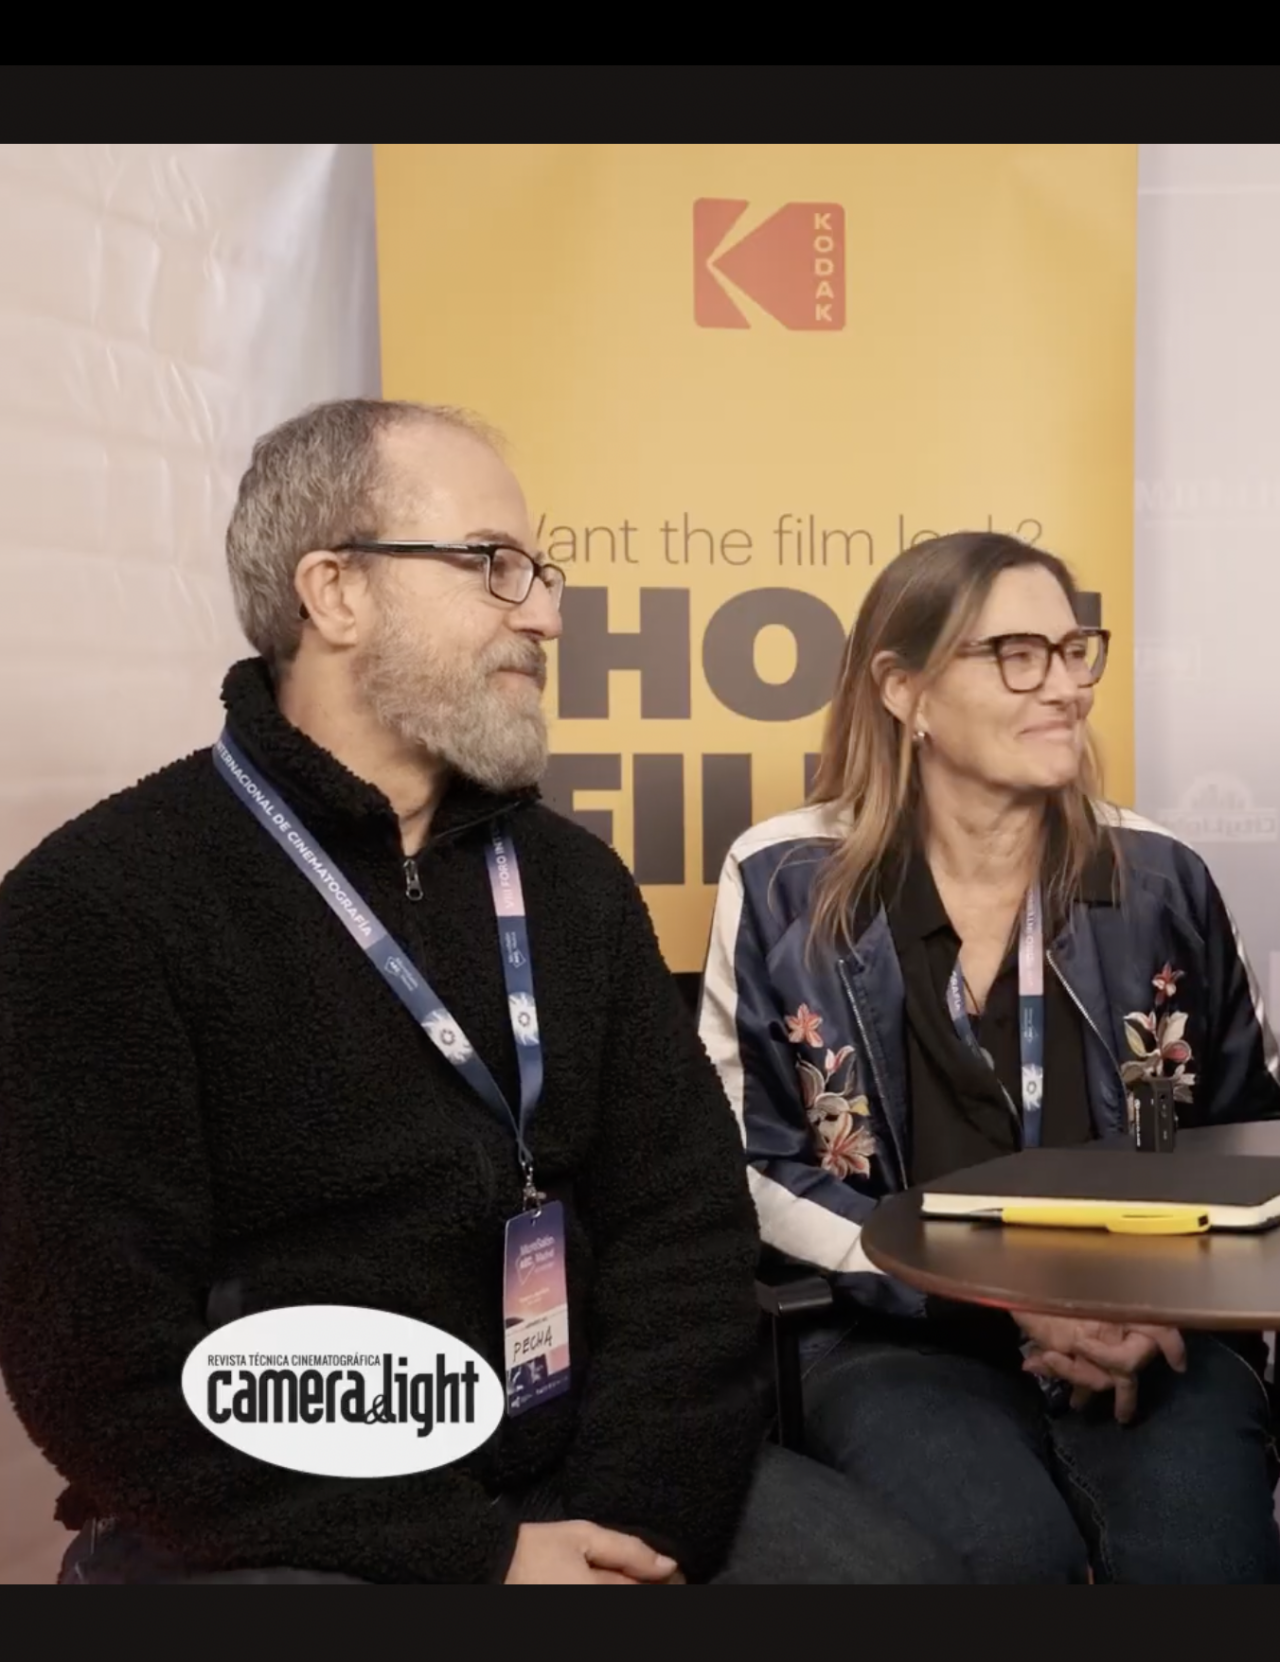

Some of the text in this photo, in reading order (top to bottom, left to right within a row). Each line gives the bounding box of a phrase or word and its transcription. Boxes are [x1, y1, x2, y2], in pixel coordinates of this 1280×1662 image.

[814, 212, 834, 322] KODAK
[531, 516, 638, 564] ant
[660, 513, 753, 565] the
[777, 514, 874, 566] film
[217, 743, 373, 938] NTERNACIONAL DE CINEMATOGRAFÍA
[546, 753, 820, 885] FIL
[496, 855, 510, 887] FORO
[513, 1325, 553, 1362] PECHA
